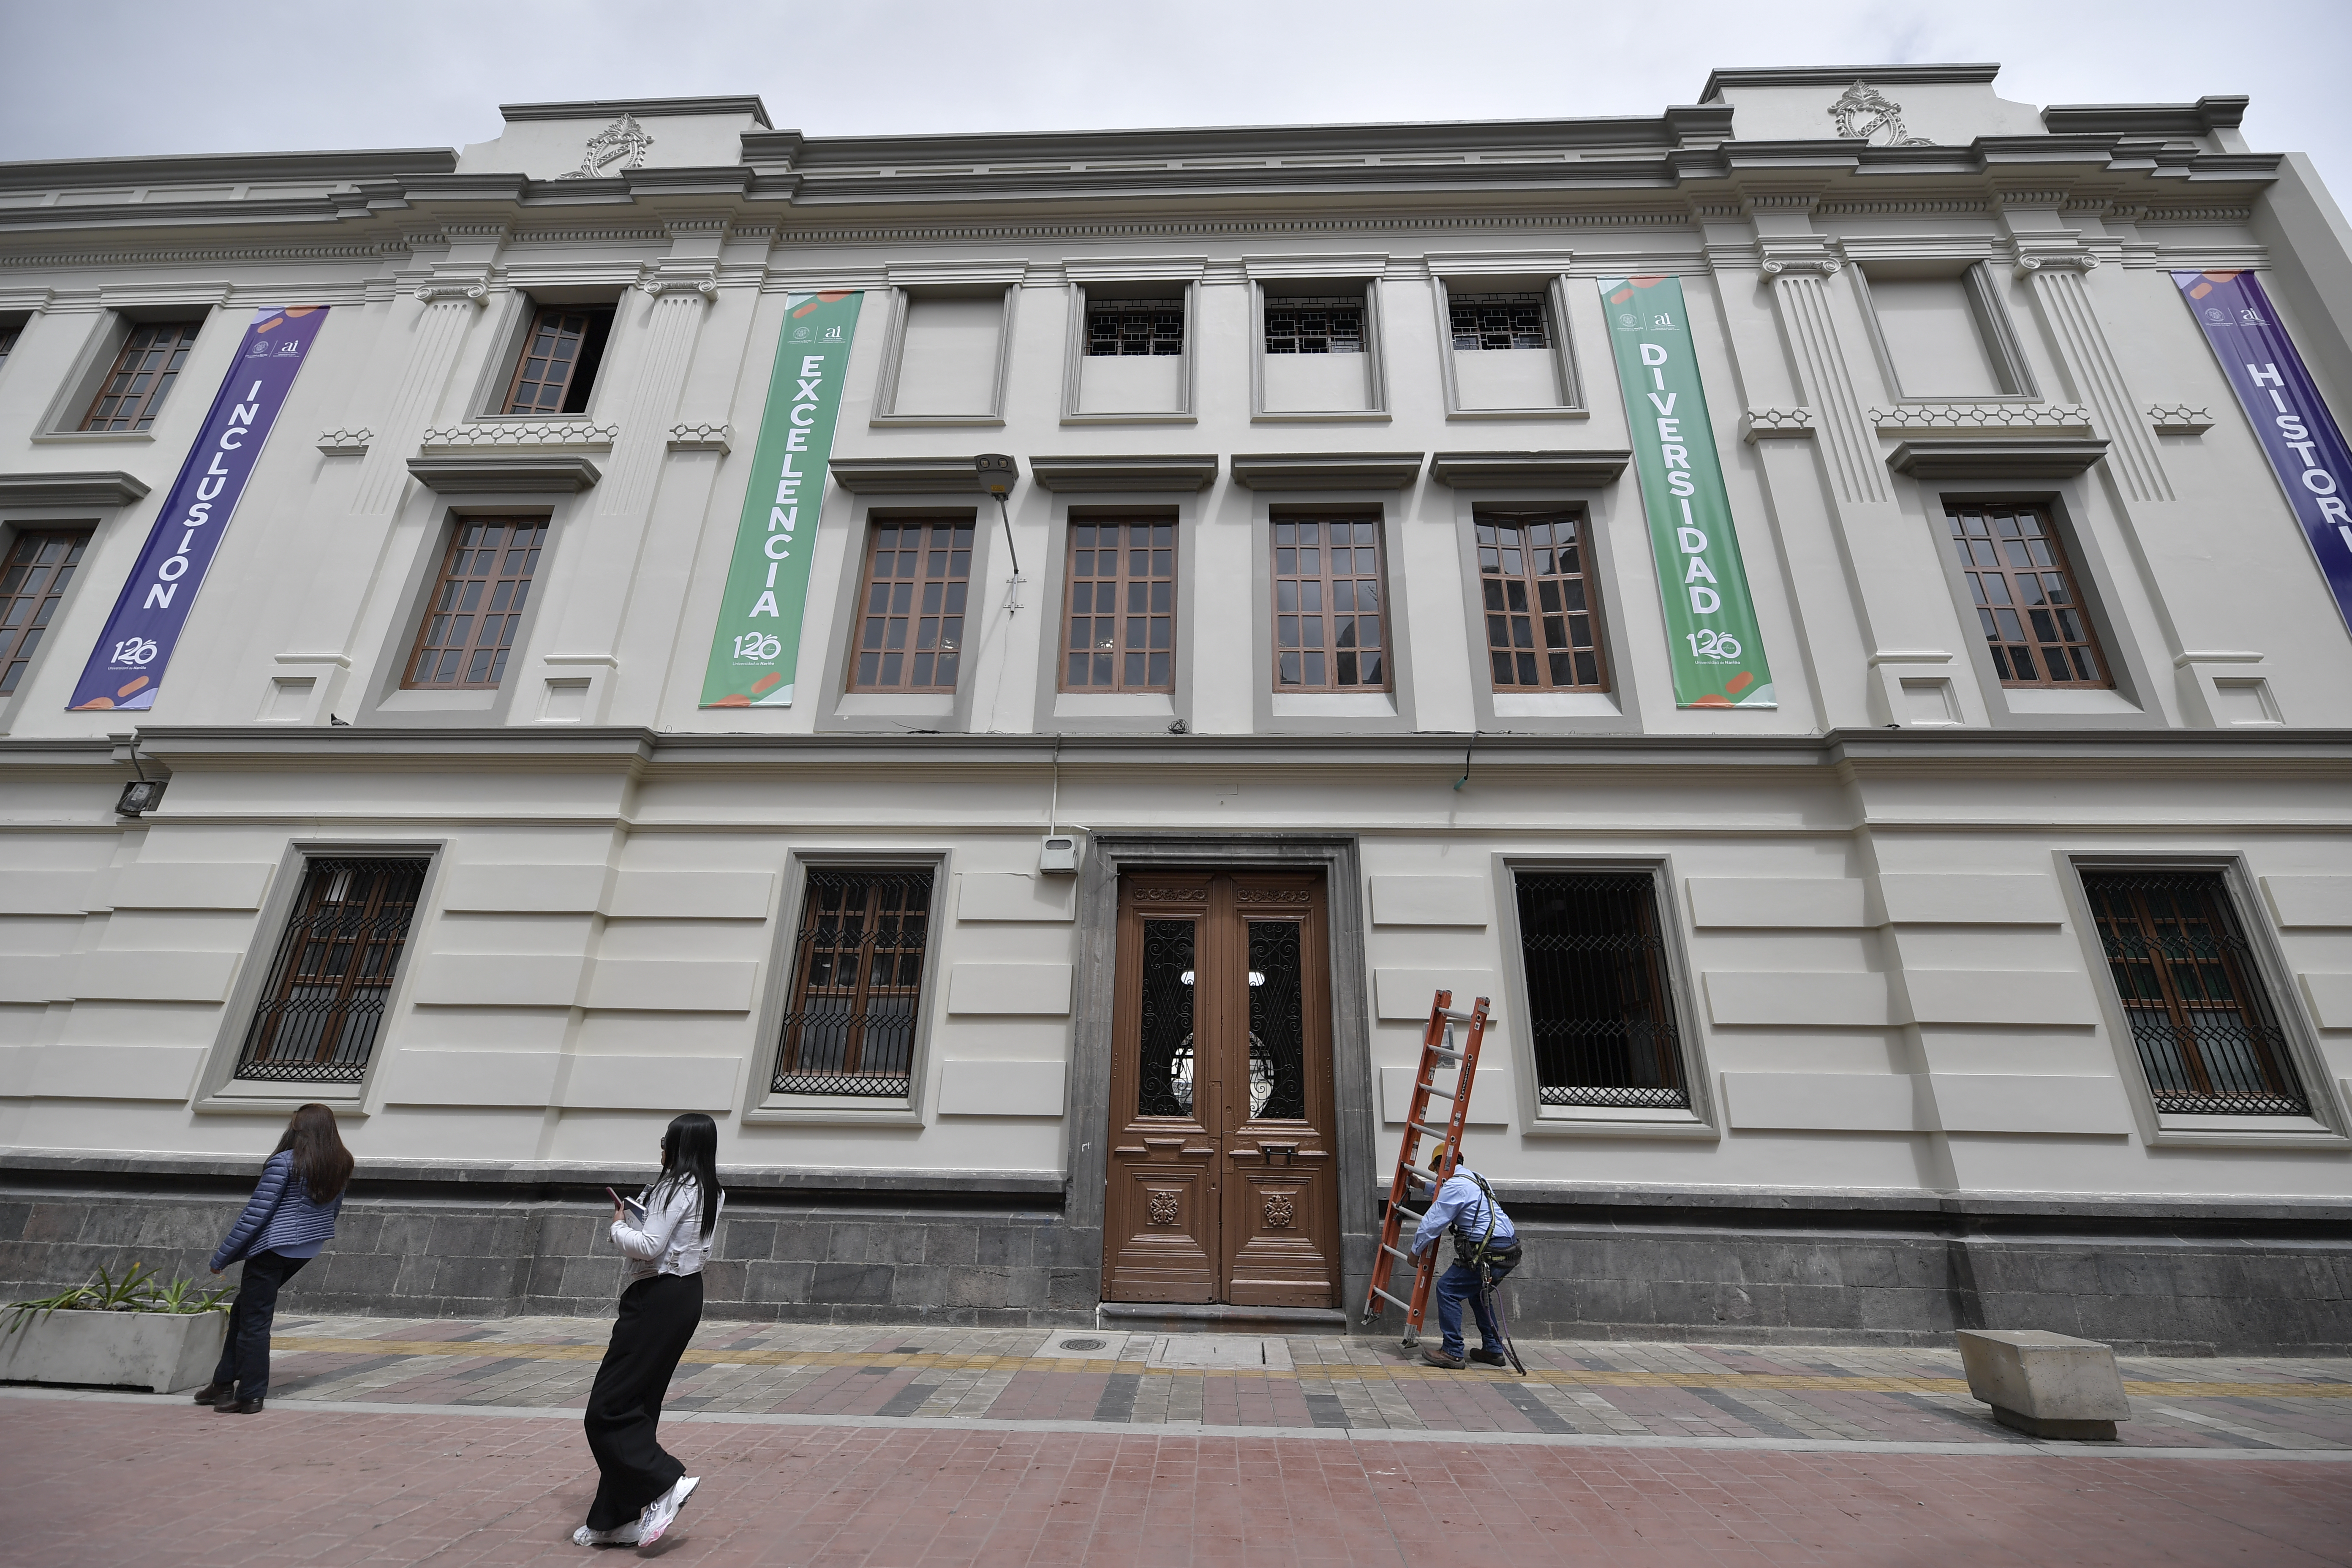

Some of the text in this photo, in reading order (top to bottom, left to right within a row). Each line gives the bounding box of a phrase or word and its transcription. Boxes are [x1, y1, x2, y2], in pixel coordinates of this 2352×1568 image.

[143, 380, 262, 609] INCLUSION
[749, 355, 825, 617] EXCELENCIA
[1639, 343, 1720, 614] DIVERSIDAD
[110, 637, 158, 665] 120
[733, 632, 781, 660] 120
[1686, 629, 1742, 659] 120
